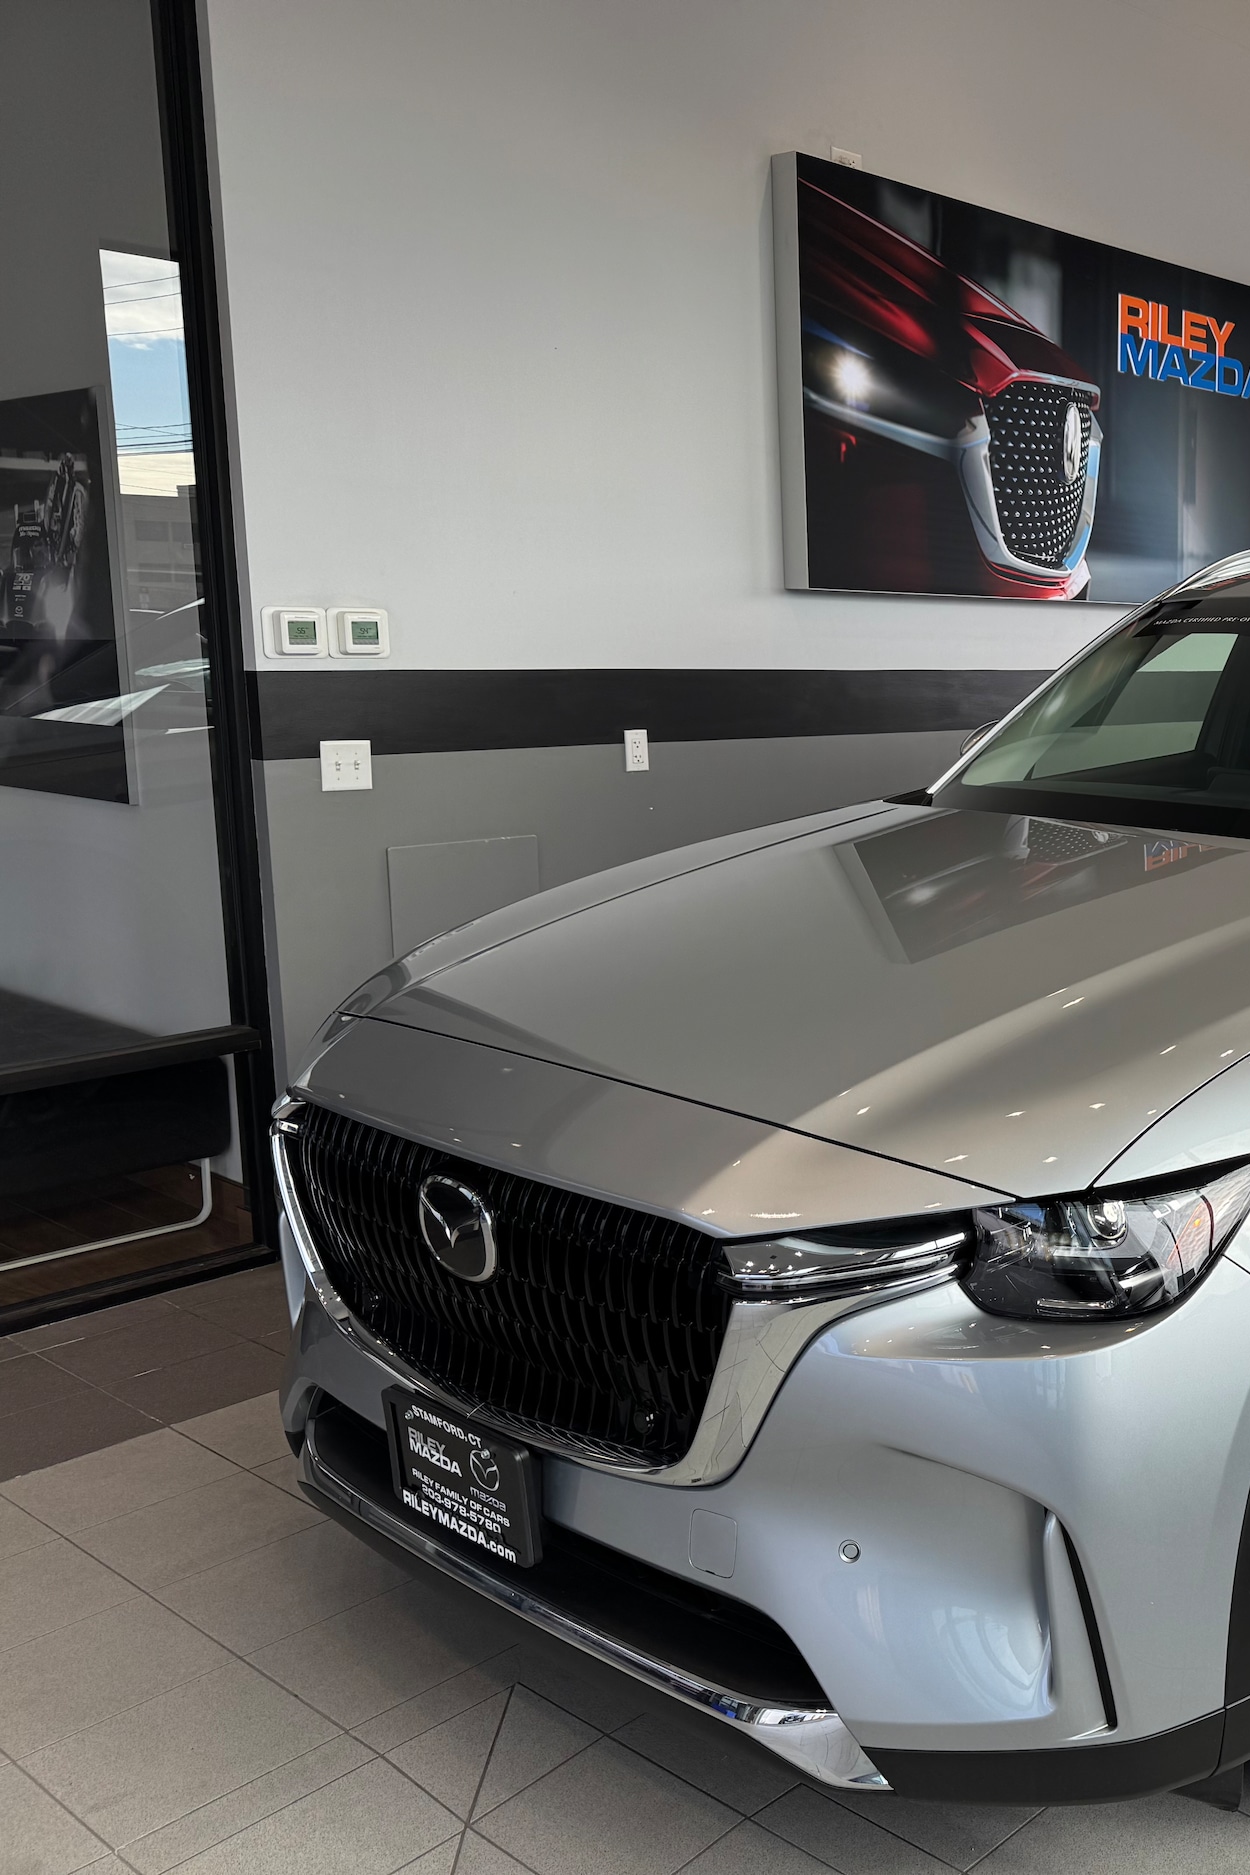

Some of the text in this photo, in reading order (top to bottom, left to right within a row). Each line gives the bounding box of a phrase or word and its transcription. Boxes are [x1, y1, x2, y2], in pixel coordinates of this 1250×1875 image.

[1118, 293, 1235, 357] RILEY
[407, 1426, 446, 1457] RILEY
[409, 1437, 463, 1478] MAZDA
[402, 1488, 517, 1564] RILEYMAZDA.com
[412, 1467, 511, 1528] RILEY FAMILY OF CARS
